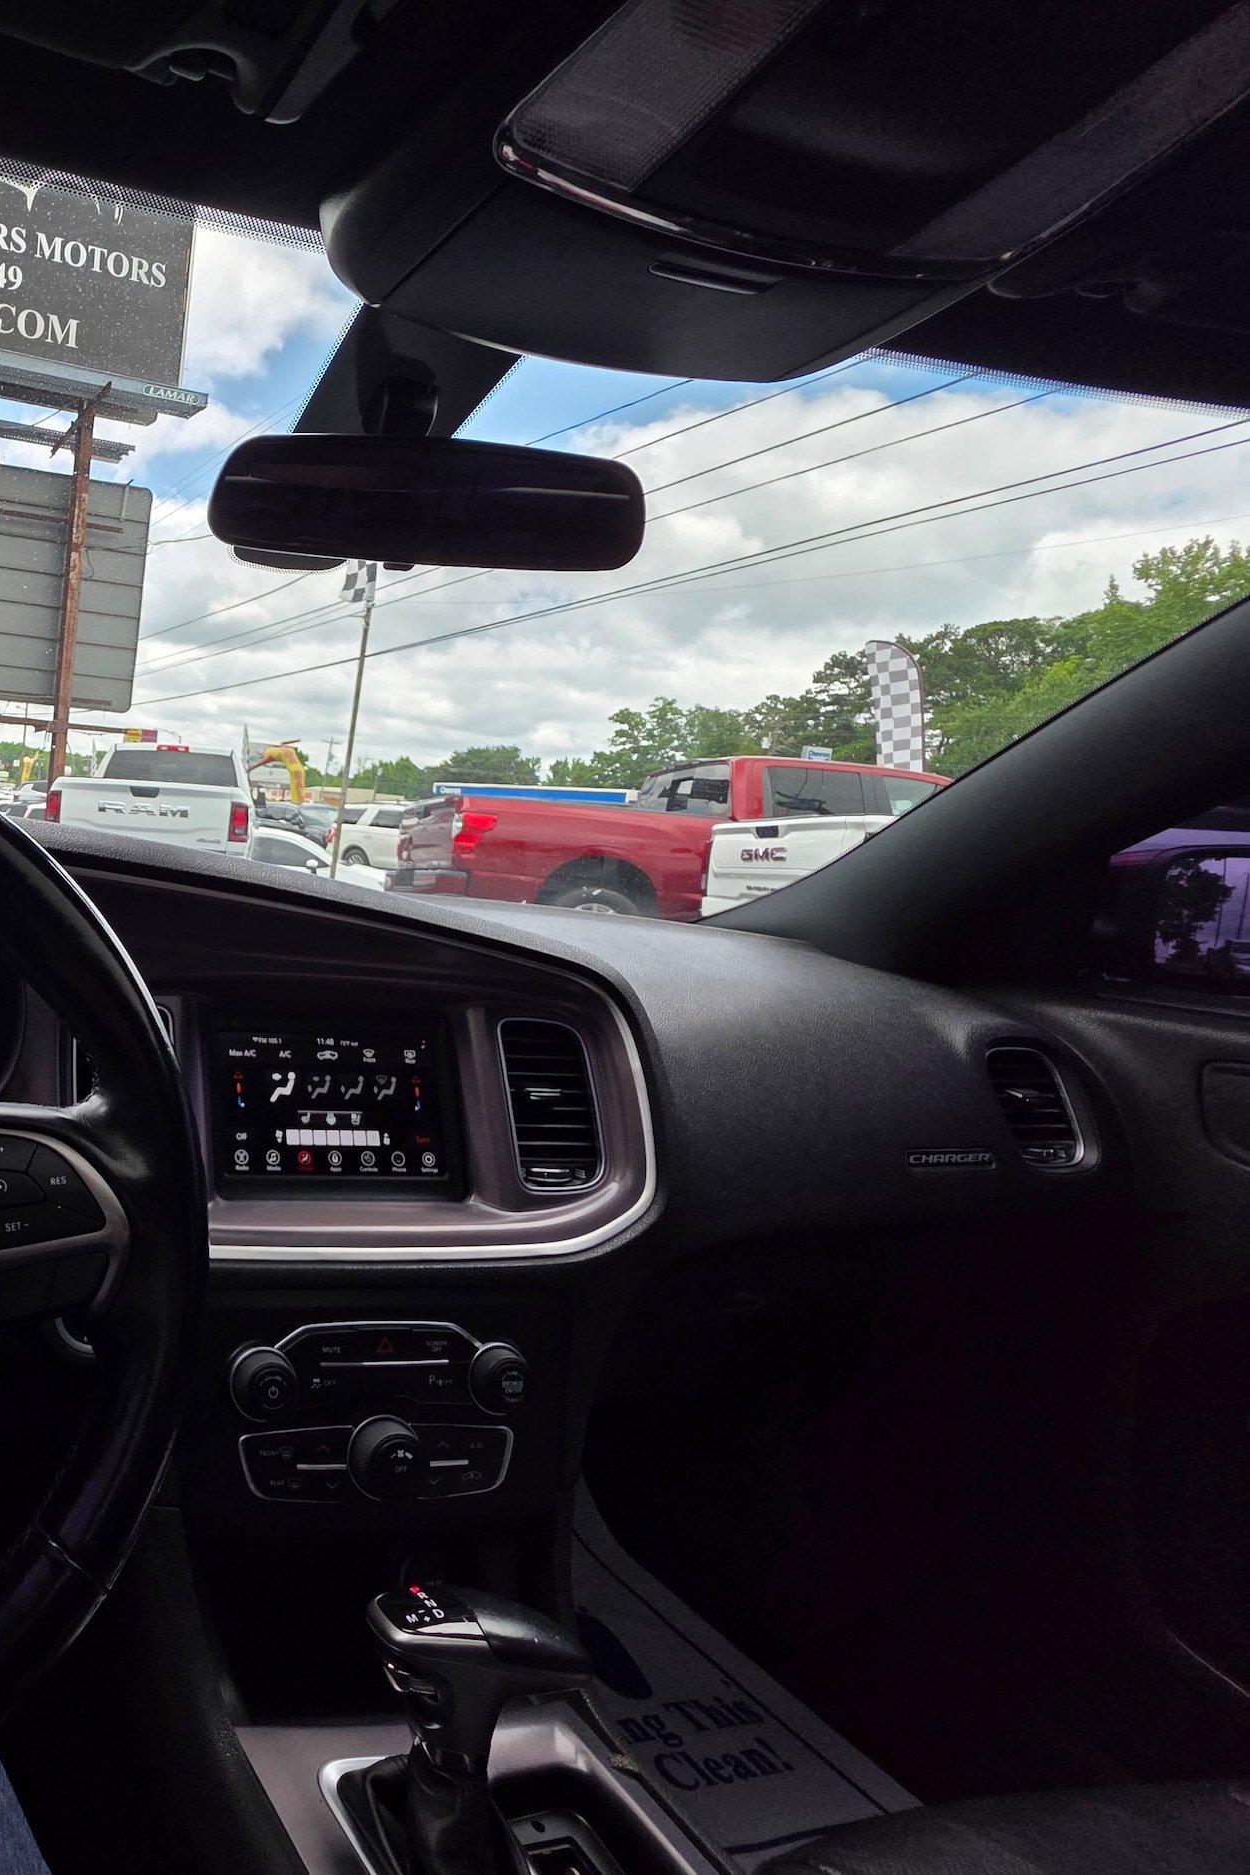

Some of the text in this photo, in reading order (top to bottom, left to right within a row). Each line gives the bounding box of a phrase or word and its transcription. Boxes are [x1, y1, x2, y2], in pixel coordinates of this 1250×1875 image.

[35, 234, 167, 288] MOTORS
[149, 386, 196, 403] LAMAR
[97, 800, 189, 818] RAM
[740, 846, 788, 862] GMC
[243, 1049, 257, 1057] A/C
[278, 1050, 292, 1058] A/C
[236, 1132, 248, 1141] Off
[908, 1152, 991, 1165] CHARGER
[50, 1175, 68, 1186] RES
[322, 1346, 342, 1354] MUTE
[416, 1591, 430, 1600] R
[423, 1598, 438, 1608] N
[405, 1613, 420, 1624] M
[431, 1608, 445, 1619] D
[664, 1697, 766, 1732] This
[653, 1736, 795, 1792] Clean!
